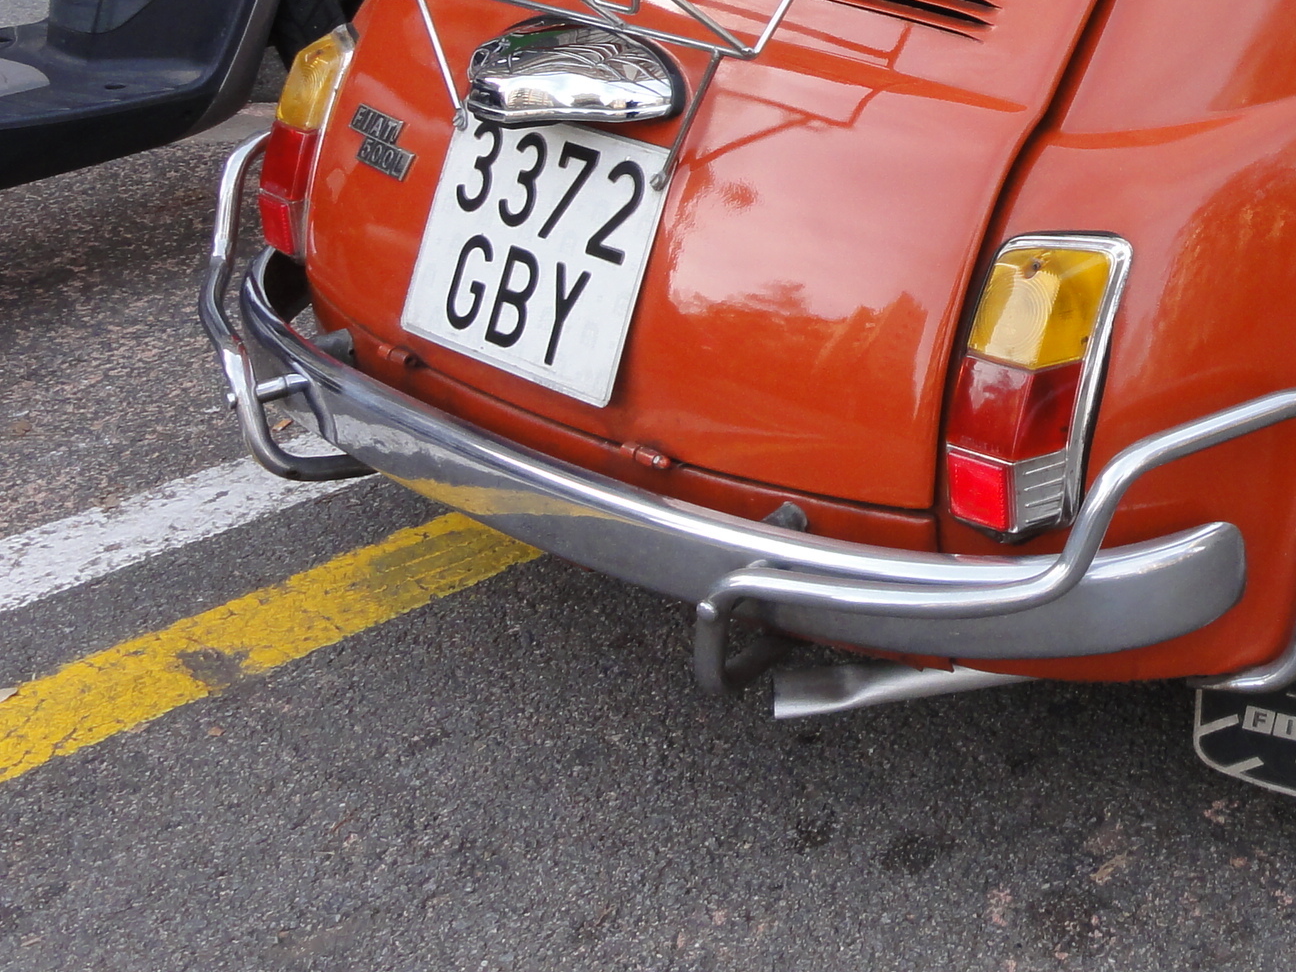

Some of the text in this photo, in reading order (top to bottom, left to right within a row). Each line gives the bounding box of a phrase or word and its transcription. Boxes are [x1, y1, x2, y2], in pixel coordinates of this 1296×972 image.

[352, 107, 398, 140] FIAT
[456, 124, 645, 266] 3372
[446, 234, 591, 366] GBY
